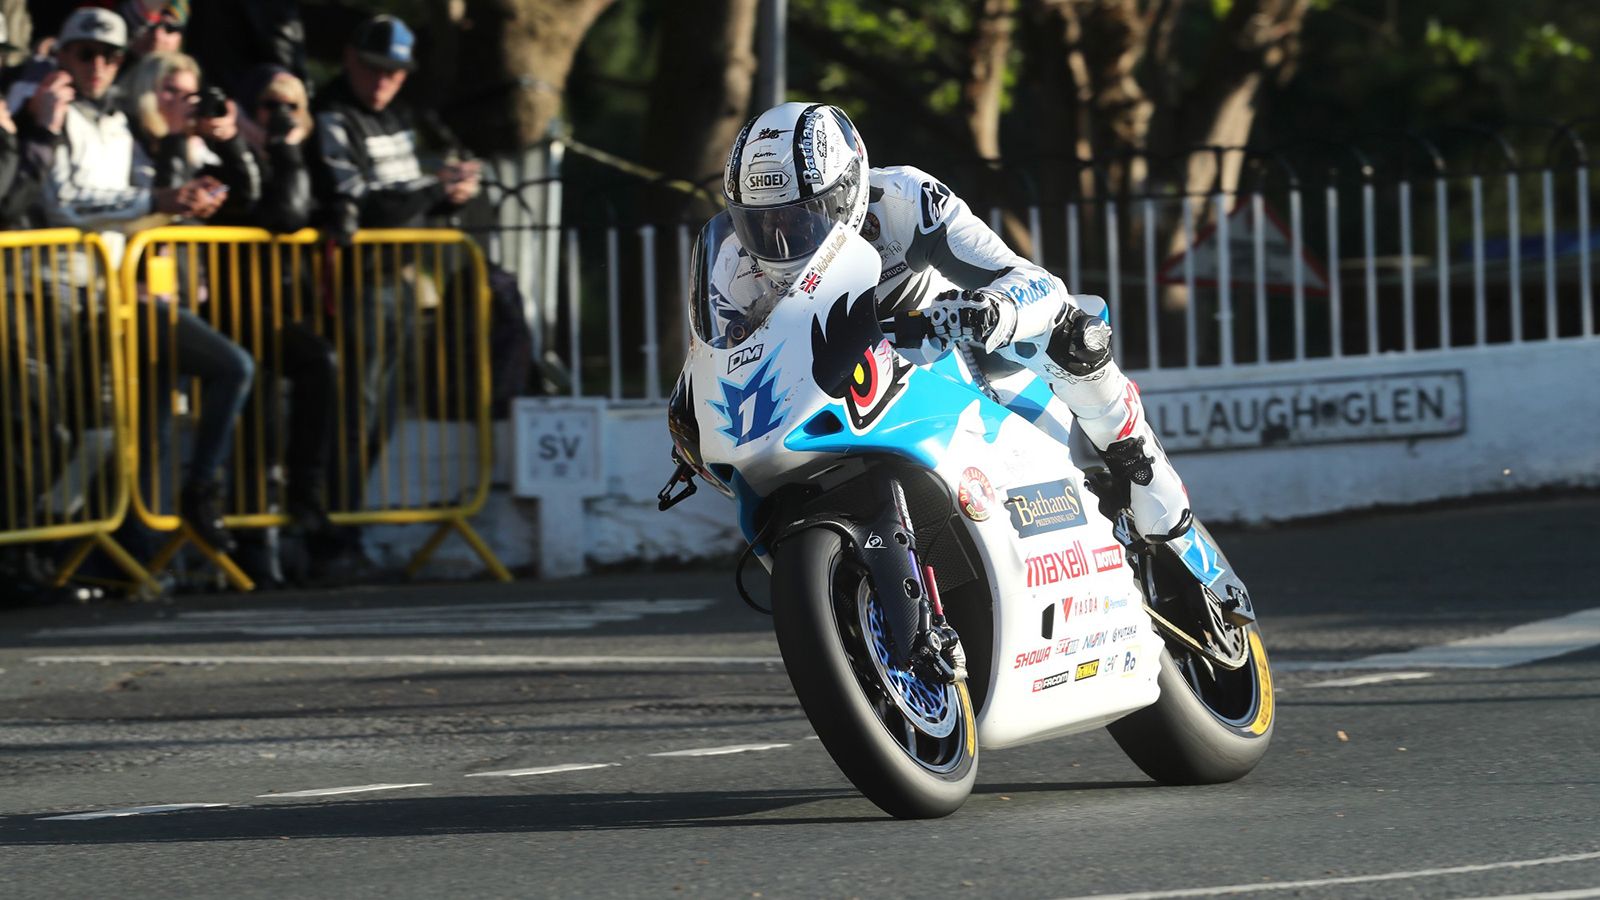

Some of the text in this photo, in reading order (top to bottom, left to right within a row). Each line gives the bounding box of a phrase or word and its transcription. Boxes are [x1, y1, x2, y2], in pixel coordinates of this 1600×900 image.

[749, 173, 783, 188] SHOEI
[728, 344, 763, 374] DM
[738, 391, 757, 437] 1
[1158, 388, 1445, 437] LLAUGH GLEN
[538, 433, 582, 461] SV
[1025, 540, 1089, 587] maxell
[1074, 597, 1098, 616] YASDA
[1014, 646, 1052, 669] SHOWA
